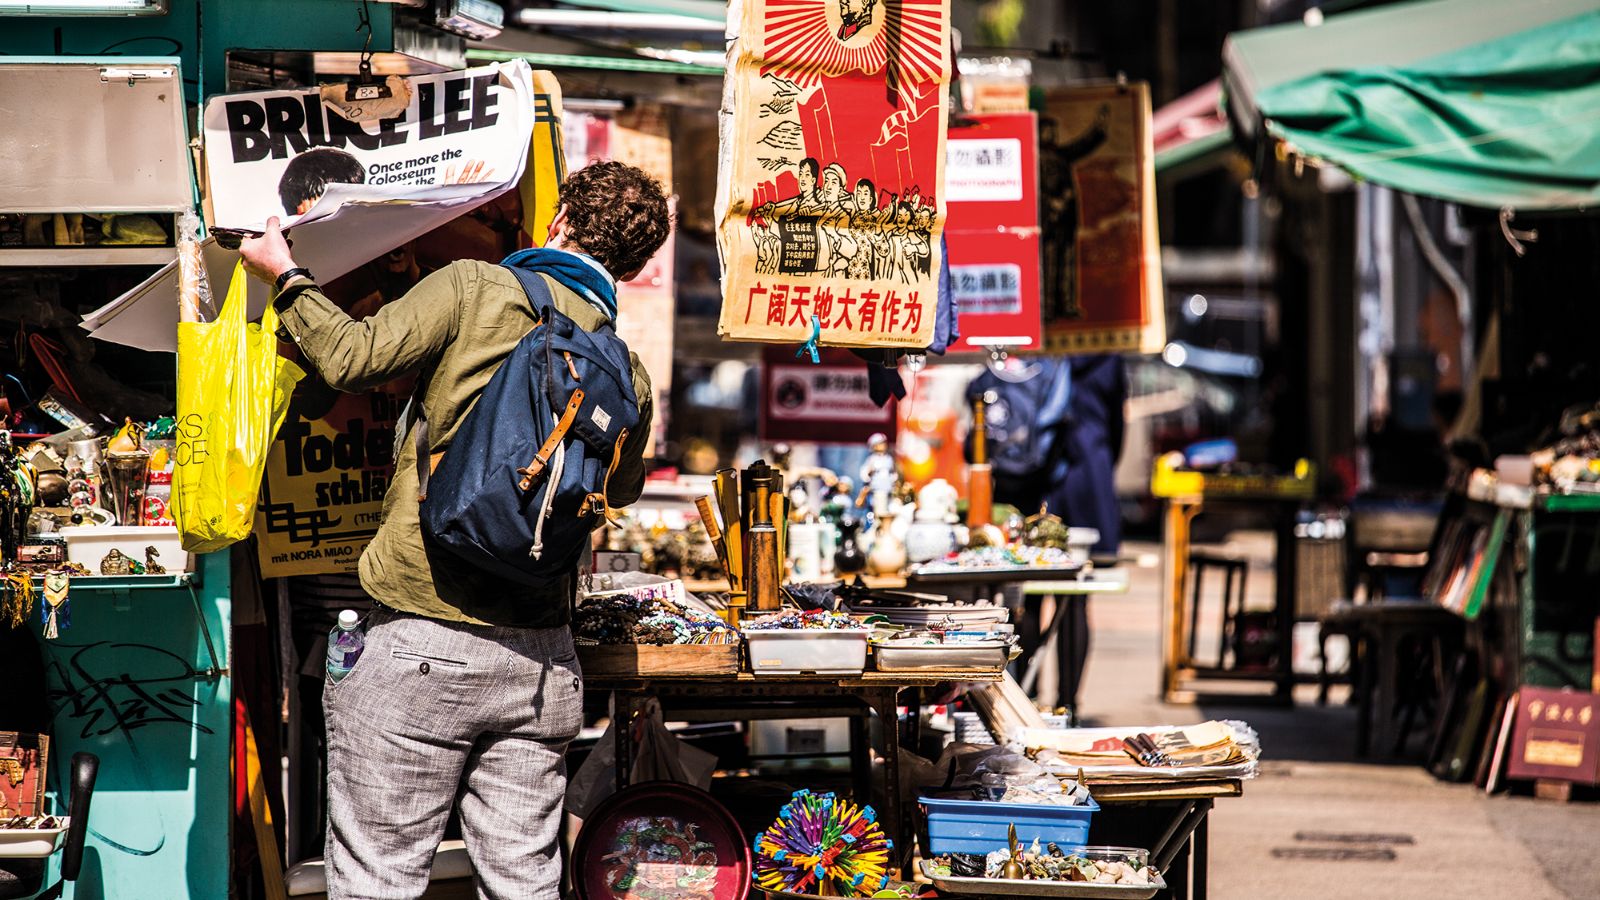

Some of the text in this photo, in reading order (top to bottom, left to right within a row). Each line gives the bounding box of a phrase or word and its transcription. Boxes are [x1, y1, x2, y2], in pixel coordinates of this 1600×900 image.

[417, 73, 501, 141] LEE
[368, 148, 462, 175] Once more the
[368, 166, 436, 185] Colosseum
[744, 281, 923, 334] 广阔天地大有作为
[176, 439, 209, 467] CE
[315, 470, 391, 508] schlä
[272, 554, 288, 564] mit
[290, 549, 321, 562] NORA
[324, 545, 353, 558] MIAO
